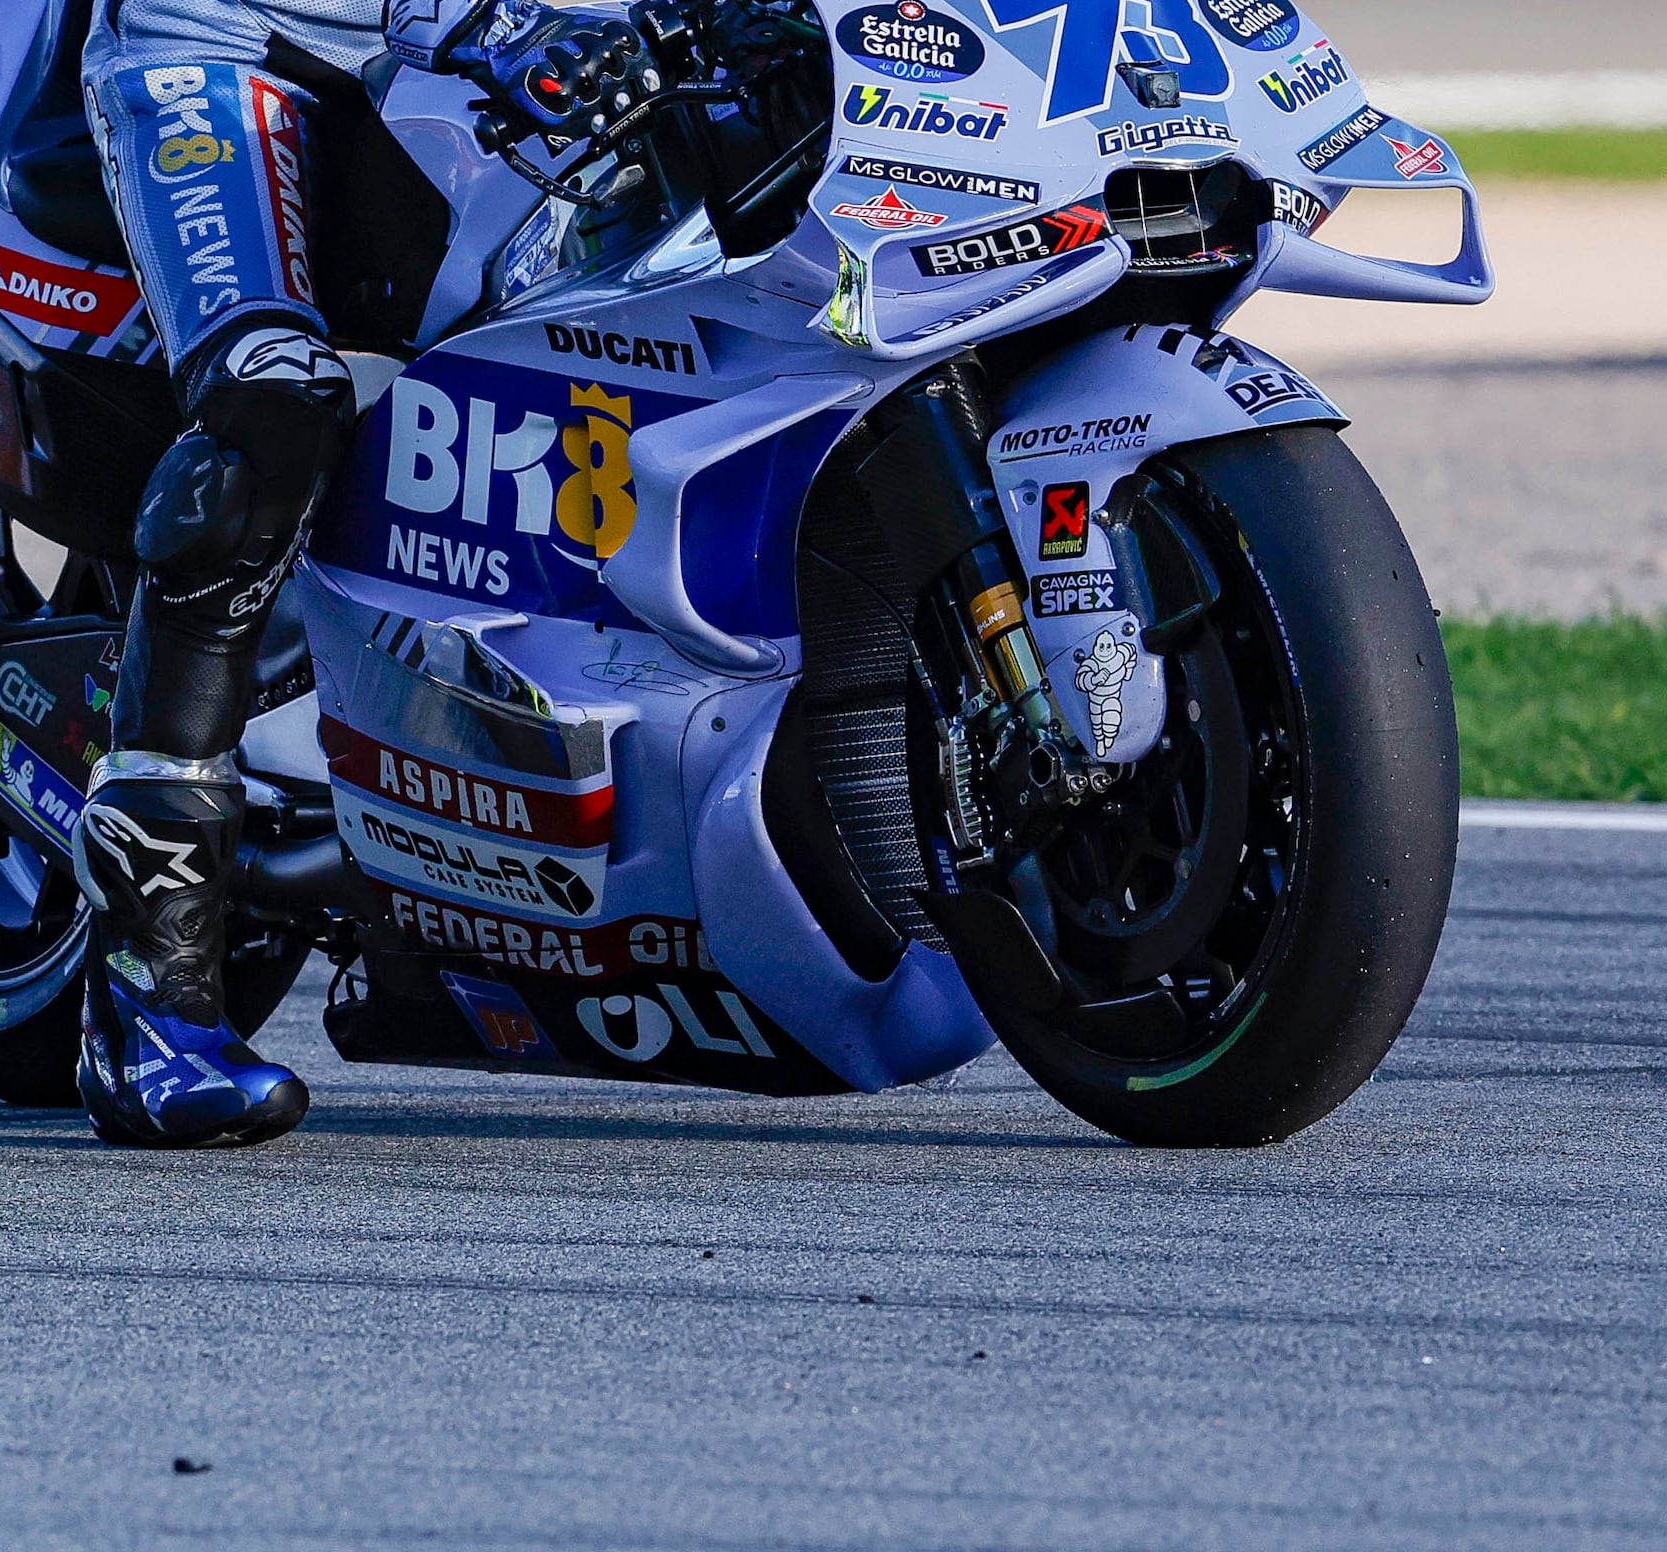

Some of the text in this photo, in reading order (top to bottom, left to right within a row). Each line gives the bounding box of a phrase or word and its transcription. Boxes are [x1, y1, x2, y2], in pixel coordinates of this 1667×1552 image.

[859, 12, 963, 50] Estrella
[1229, 0, 1286, 39] Galicia
[861, 37, 958, 71] Galicia
[1256, 47, 1351, 114] Unibat
[842, 82, 1010, 144] Unibat
[1320, 108, 1384, 157] GLOW MEN
[1095, 114, 1243, 158] Gigetta
[848, 156, 1040, 202] MS GLOW MEN
[840, 205, 943, 230] FEDERAL OIL
[1271, 181, 1321, 231] BOLD
[168, 182, 243, 317] NEWS
[927, 223, 1043, 268] BOLD
[934, 243, 1052, 276] RIDERS
[7, 270, 98, 314] DAIKO
[544, 322, 698, 376] DUCATI
[999, 411, 1152, 454] MOTO-TRON
[1068, 434, 1148, 458] RACING
[383, 375, 640, 560] BK8
[386, 523, 511, 597] NEWS
[1039, 571, 1115, 591] CAVAGNA
[1040, 586, 1115, 614] SIPEX
[380, 749, 534, 834] ASPIRA
[361, 809, 537, 888] MODULA
[423, 863, 545, 907] CASE SYSTEM
[391, 892, 604, 977] FEDERAL
[575, 982, 777, 1064] OLI
